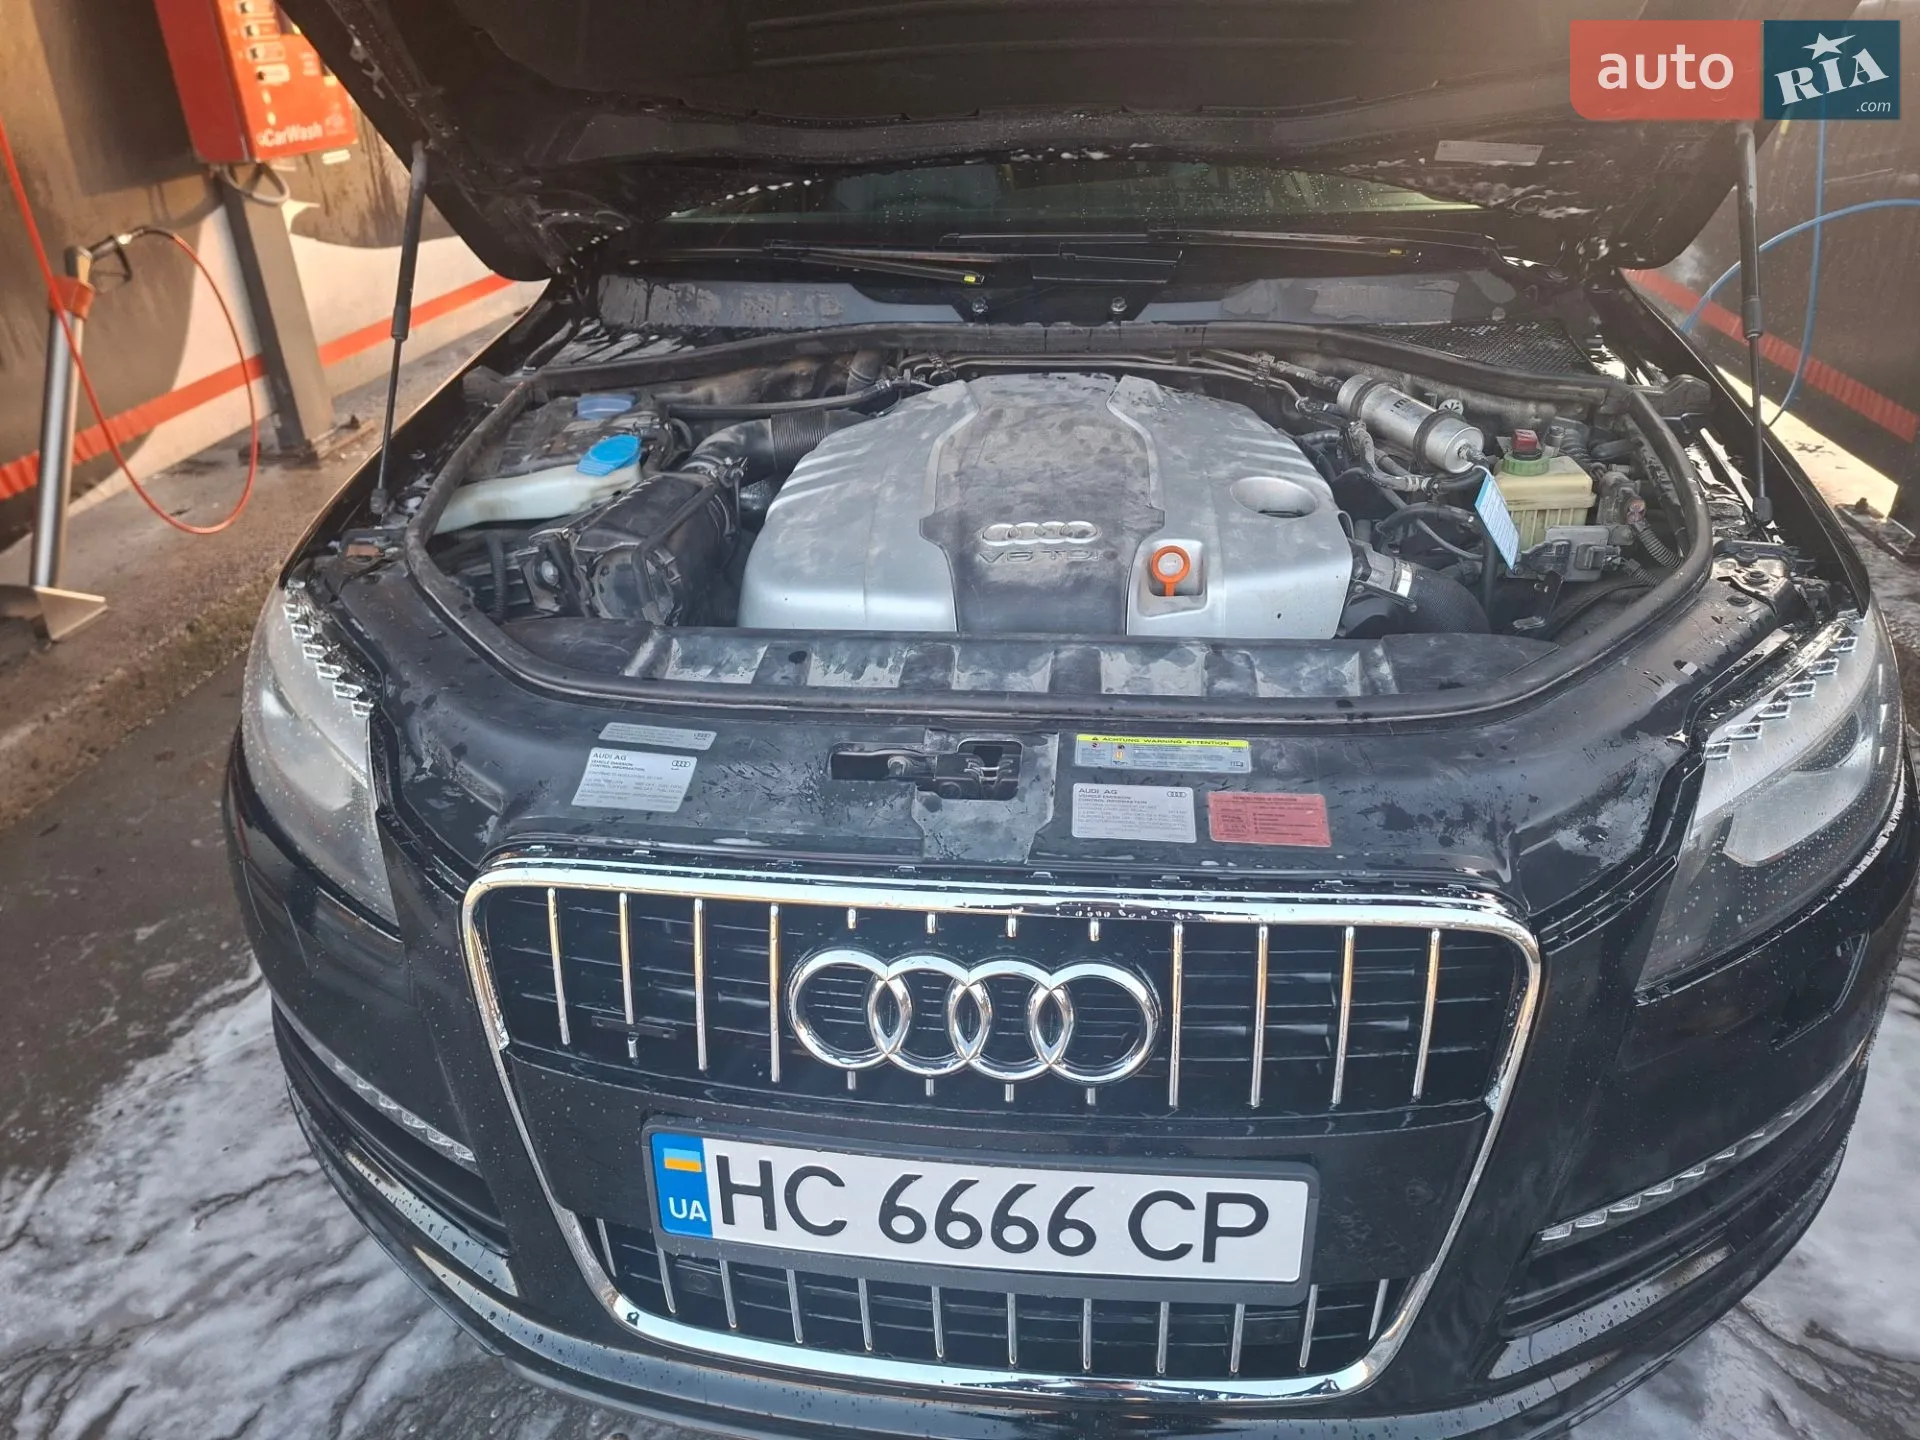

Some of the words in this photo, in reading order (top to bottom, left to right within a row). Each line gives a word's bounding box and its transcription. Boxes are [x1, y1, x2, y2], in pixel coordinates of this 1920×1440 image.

[592, 752, 612, 760] AUDI
[668, 1196, 708, 1224] UA
[716, 1155, 848, 1238] HC
[878, 1173, 1098, 1258] 6666
[1127, 1190, 1270, 1263] CP
